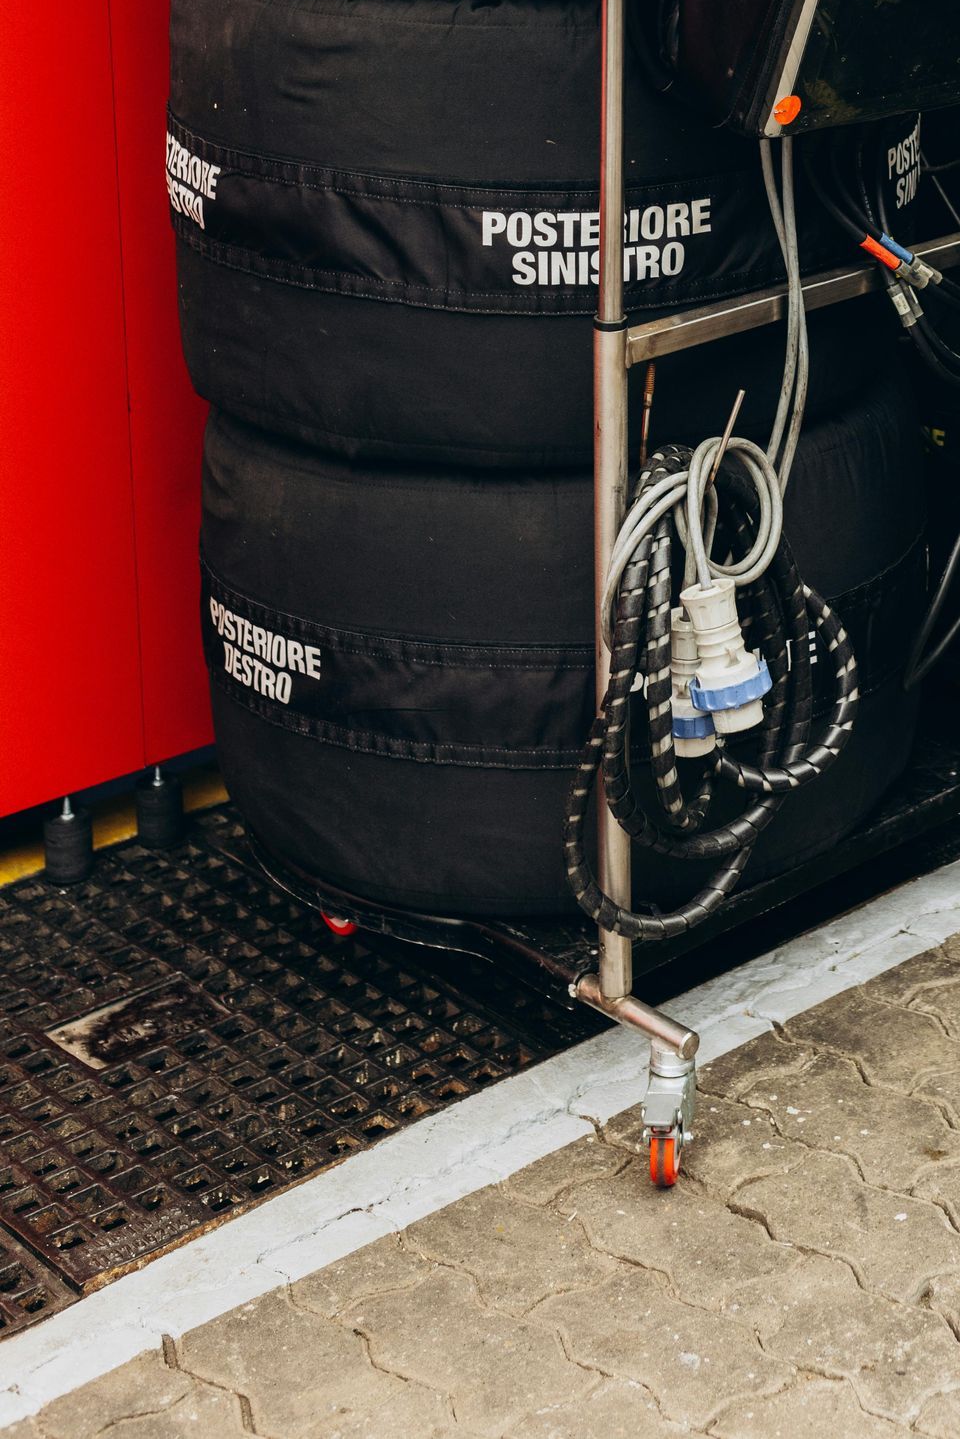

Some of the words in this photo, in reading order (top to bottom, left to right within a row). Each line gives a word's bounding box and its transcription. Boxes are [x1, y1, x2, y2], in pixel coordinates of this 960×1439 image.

[482, 198, 712, 247] POSTEIORE
[209, 596, 321, 681] POSTERIORE
[223, 641, 292, 705] DESTRO
